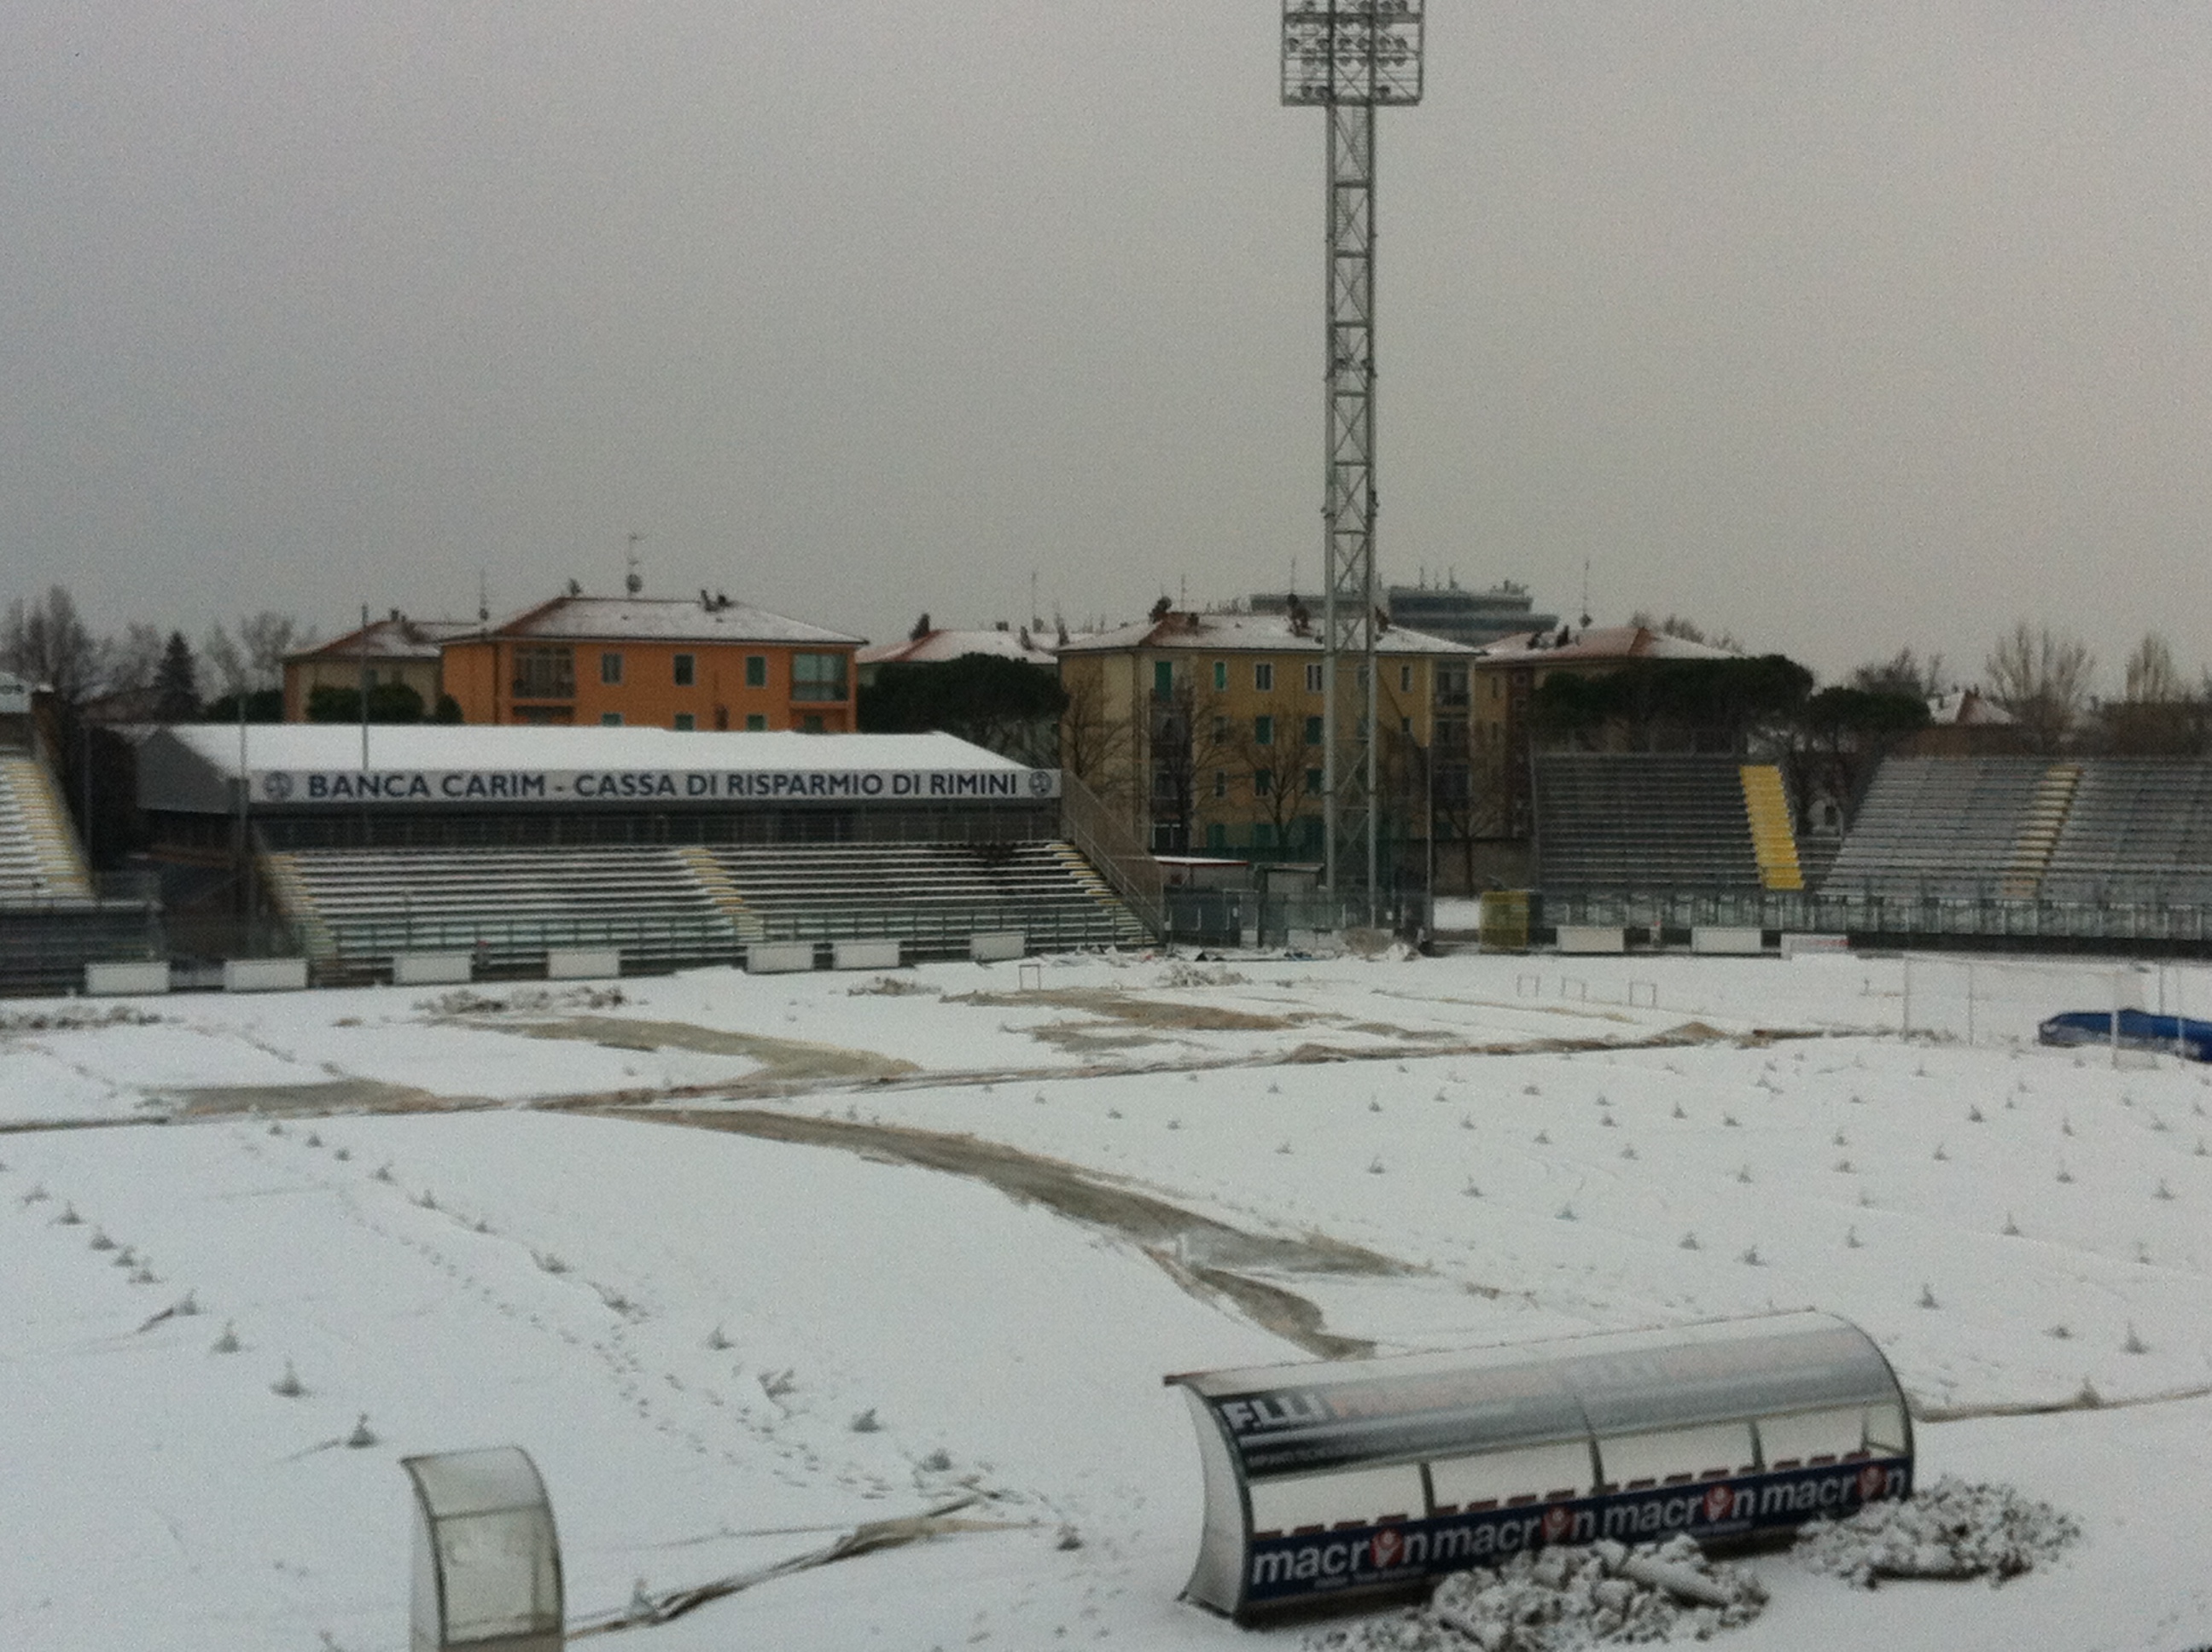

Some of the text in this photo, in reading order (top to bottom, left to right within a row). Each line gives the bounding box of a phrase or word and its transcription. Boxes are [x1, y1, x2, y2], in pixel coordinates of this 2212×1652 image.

[307, 774, 429, 799] BANCA
[440, 774, 545, 798] CARIM
[573, 774, 677, 797] CASSA
[687, 774, 717, 796] DI
[727, 772, 884, 796] RISPARMIO
[893, 772, 921, 794] DI
[932, 772, 1017, 794] RIMINI
[1252, 1527, 1429, 1585] macron
[1431, 1504, 1595, 1558] macron
[1603, 1483, 1755, 1535] macron
[1760, 1463, 1906, 1515] macron
